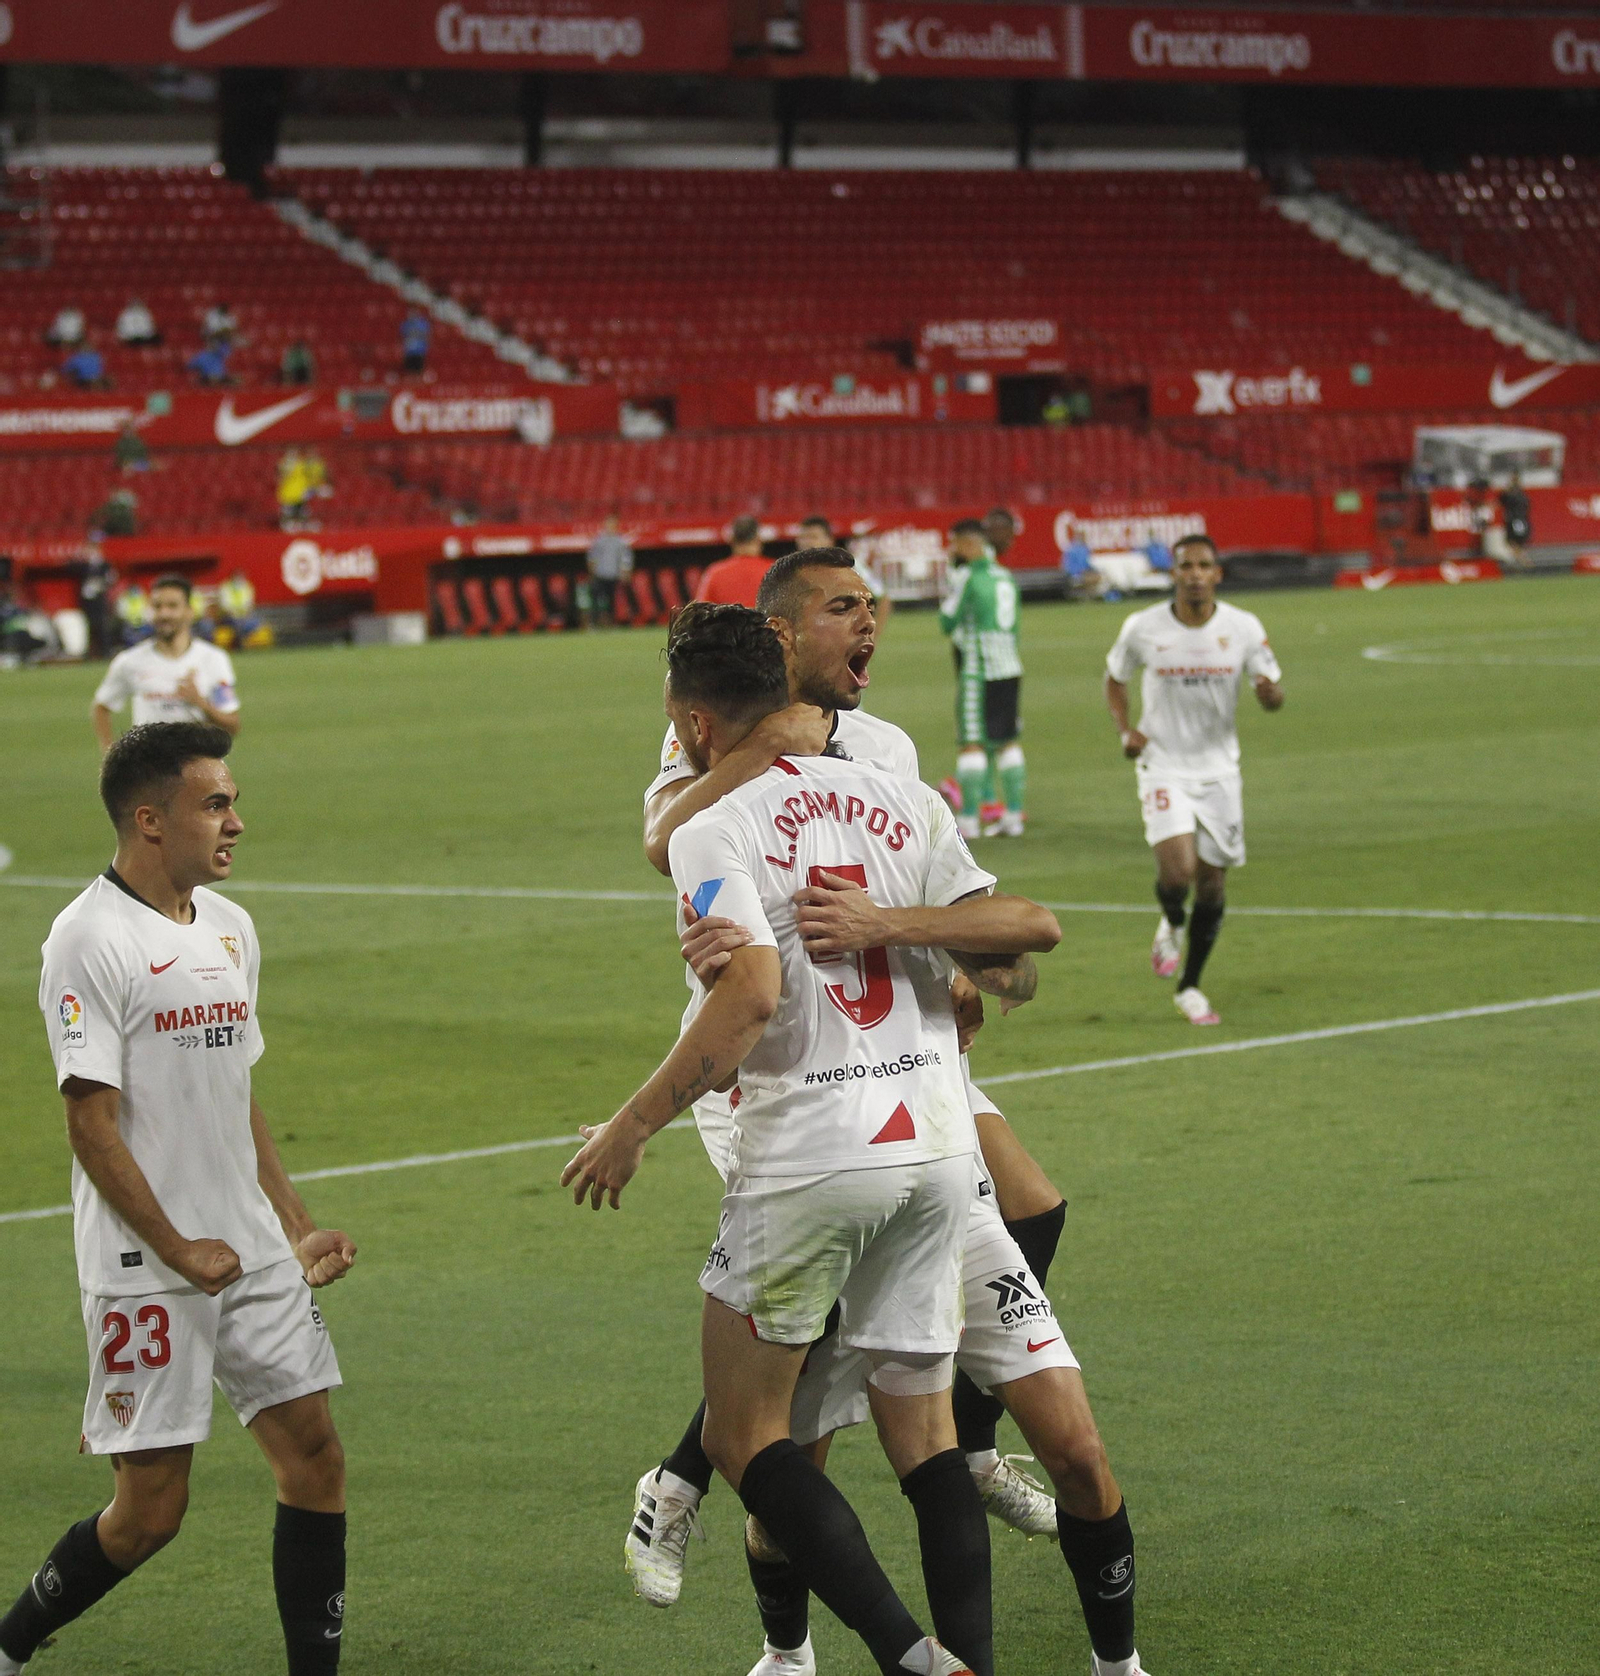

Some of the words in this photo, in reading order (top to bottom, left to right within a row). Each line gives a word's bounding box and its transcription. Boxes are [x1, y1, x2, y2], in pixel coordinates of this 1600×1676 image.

[435, 4, 645, 63] Cruzcampo
[1130, 20, 1311, 76] Cruzcampo
[391, 391, 553, 436] Cruzcamp
[204, 1025, 235, 1049] BET
[101, 1304, 172, 1375] 23
